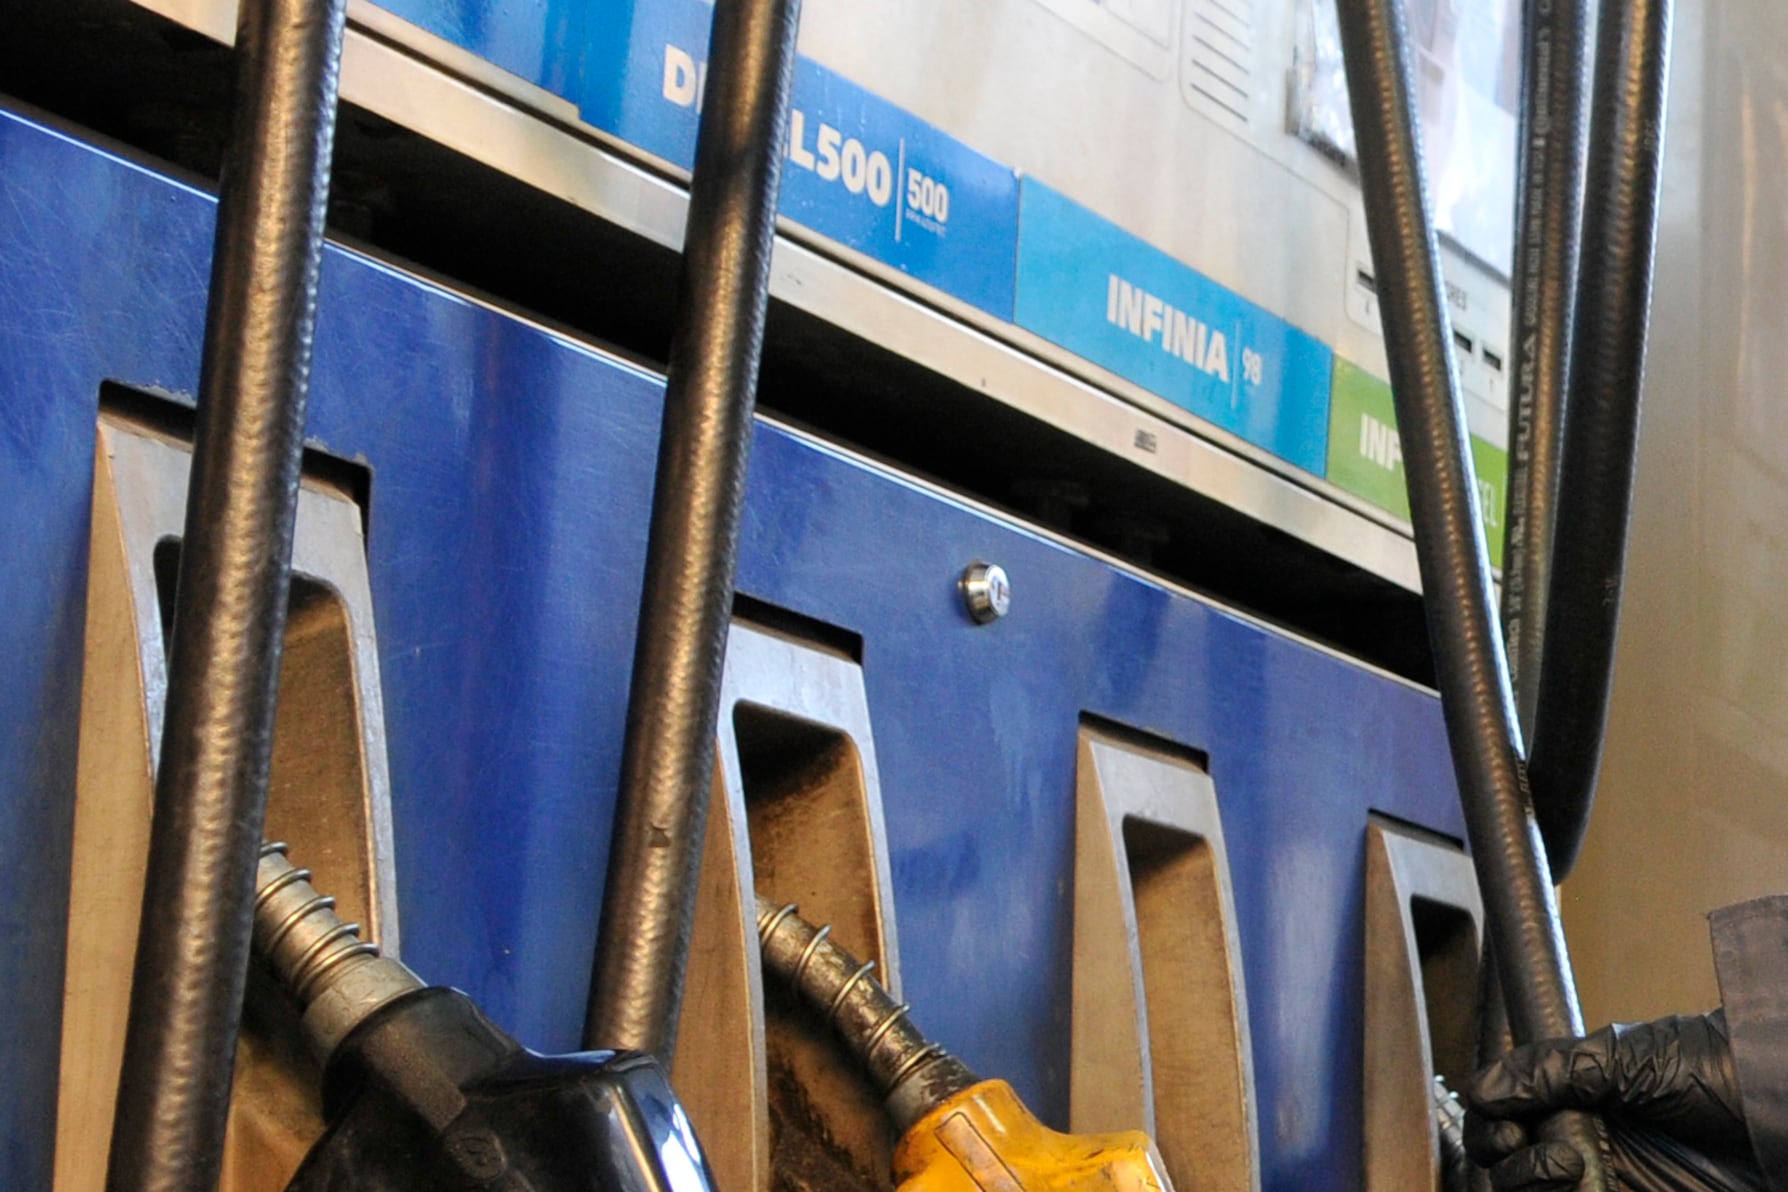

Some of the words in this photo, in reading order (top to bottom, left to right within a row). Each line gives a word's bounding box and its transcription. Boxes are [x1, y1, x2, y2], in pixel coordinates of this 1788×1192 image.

[907, 168, 949, 224] 500
[1107, 272, 1230, 384] INFINIA
[1242, 346, 1263, 387] 98
[1517, 333, 1537, 460] FUTURA
